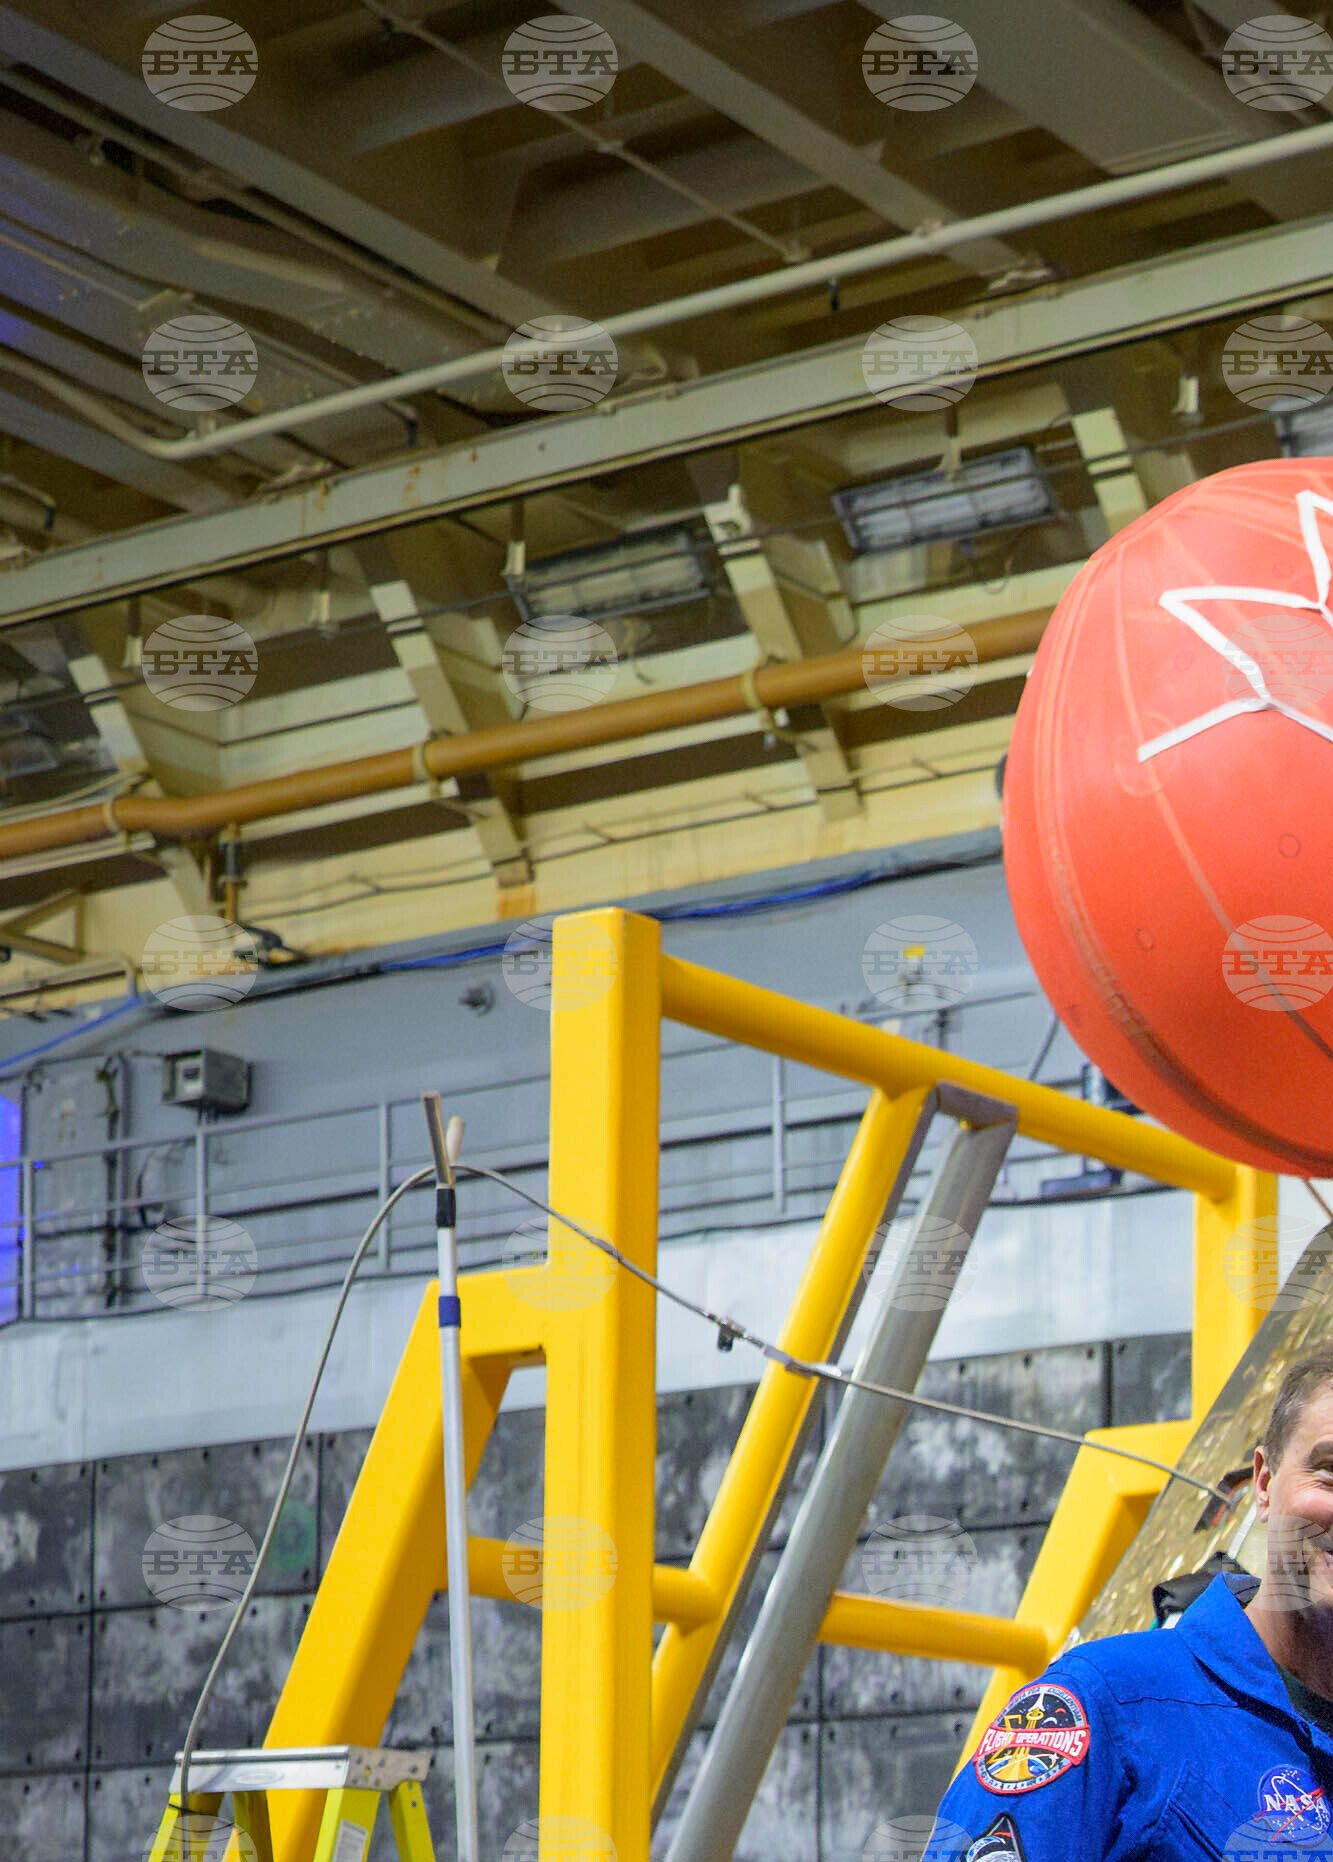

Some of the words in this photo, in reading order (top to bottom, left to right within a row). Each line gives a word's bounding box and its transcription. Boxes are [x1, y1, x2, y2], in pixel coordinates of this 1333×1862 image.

[979, 1729, 1017, 1755] FLIGHT
[1016, 1730, 1086, 1757] OPERATIONS
[1263, 1794, 1329, 1818] NASA
